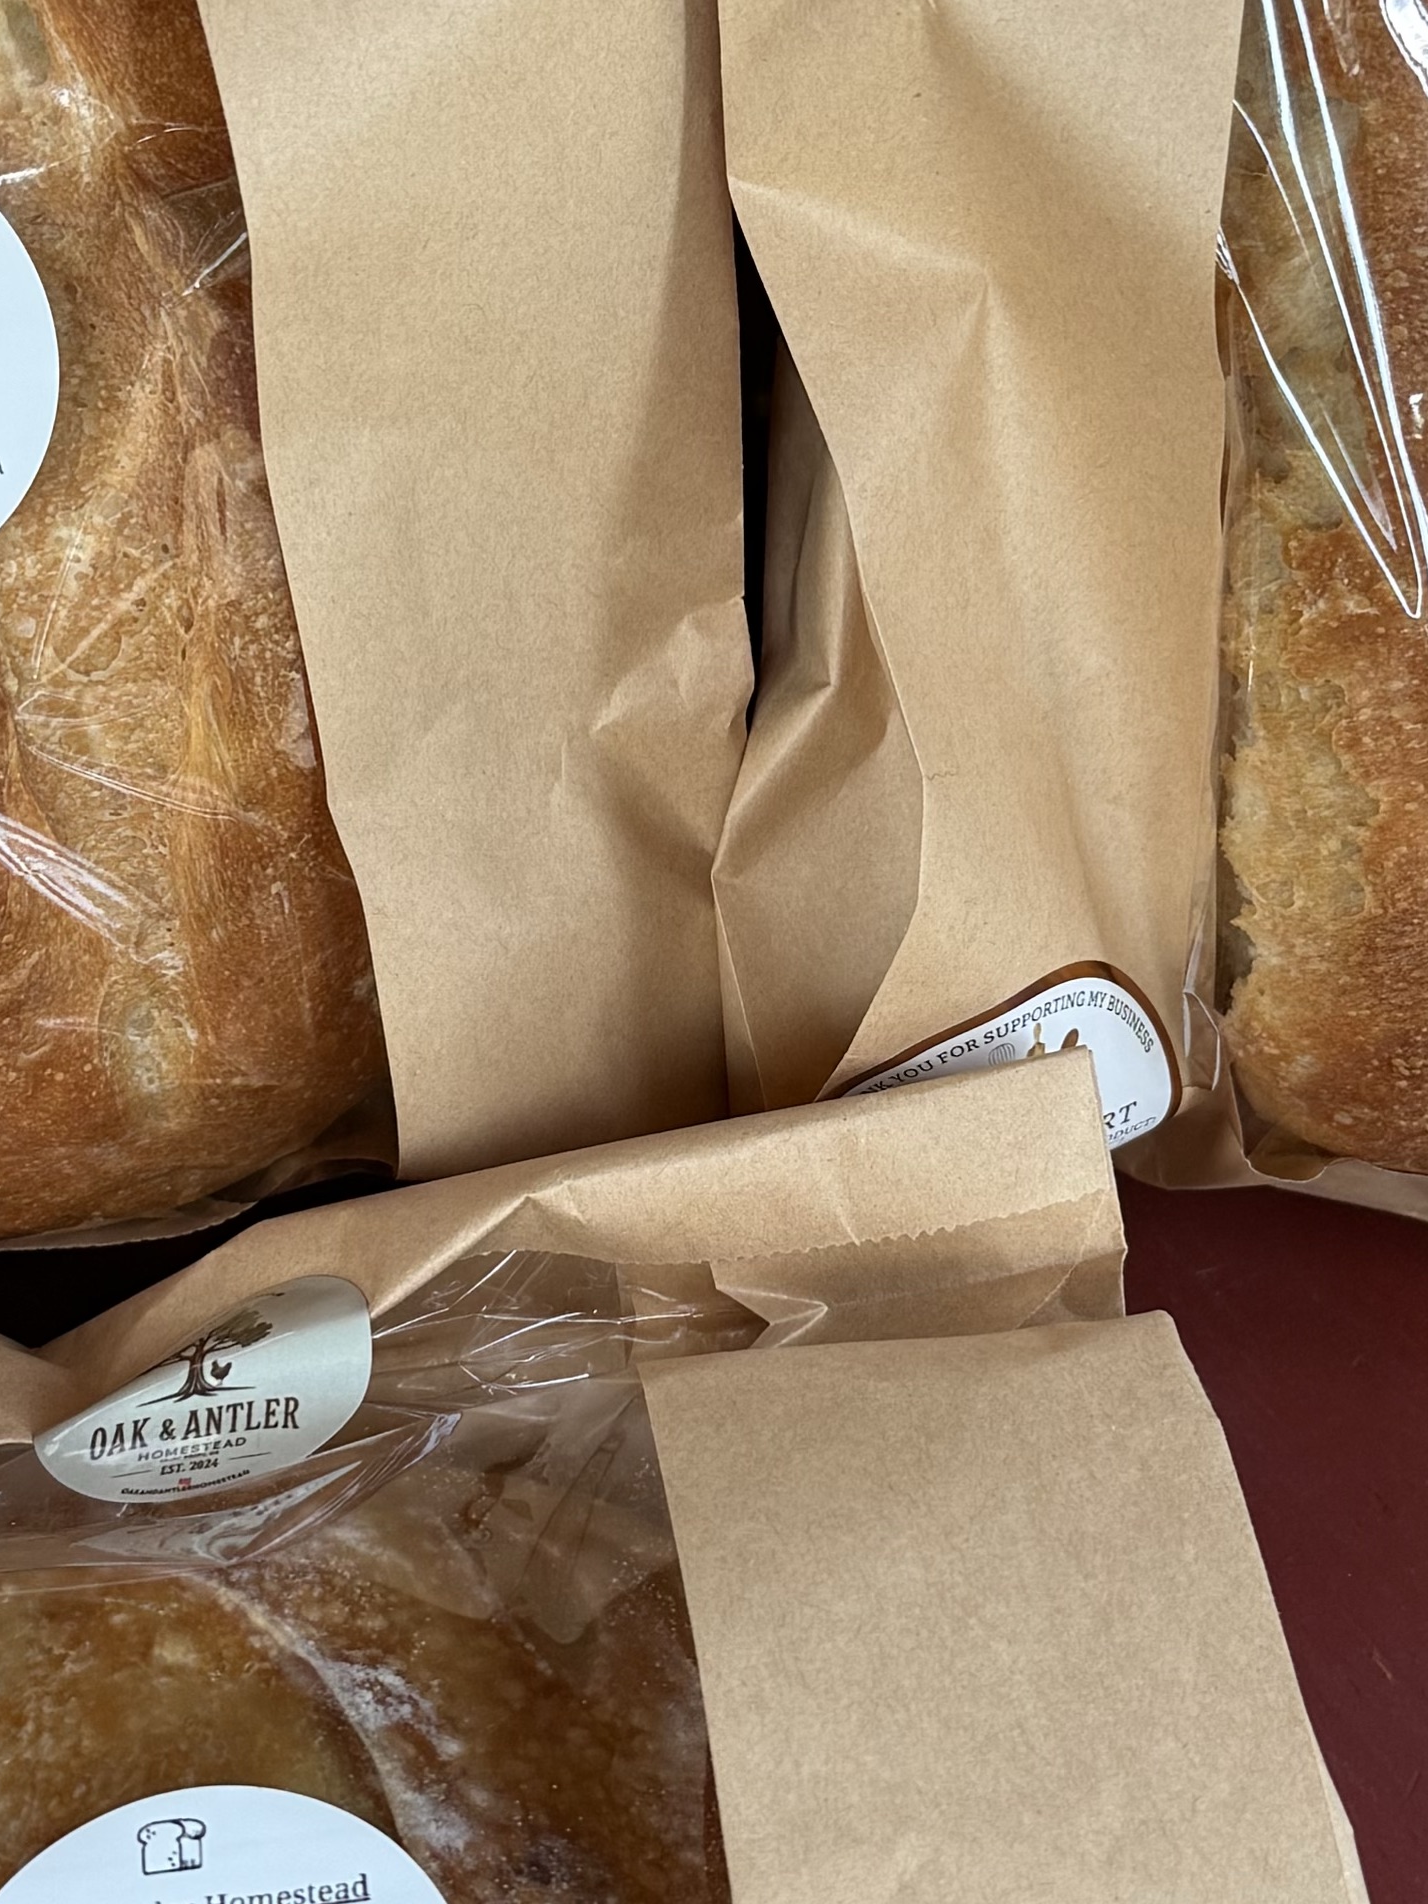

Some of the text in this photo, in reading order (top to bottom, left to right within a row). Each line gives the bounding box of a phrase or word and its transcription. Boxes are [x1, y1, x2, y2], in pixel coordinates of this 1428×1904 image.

[889, 990, 1154, 1083] YOU FOR SUPPORTING MY BUSINESS
[89, 1396, 300, 1462] OAK & ANTLER
[137, 1436, 247, 1462] HOMESTEAD
[160, 1458, 220, 1476] EST. 2024
